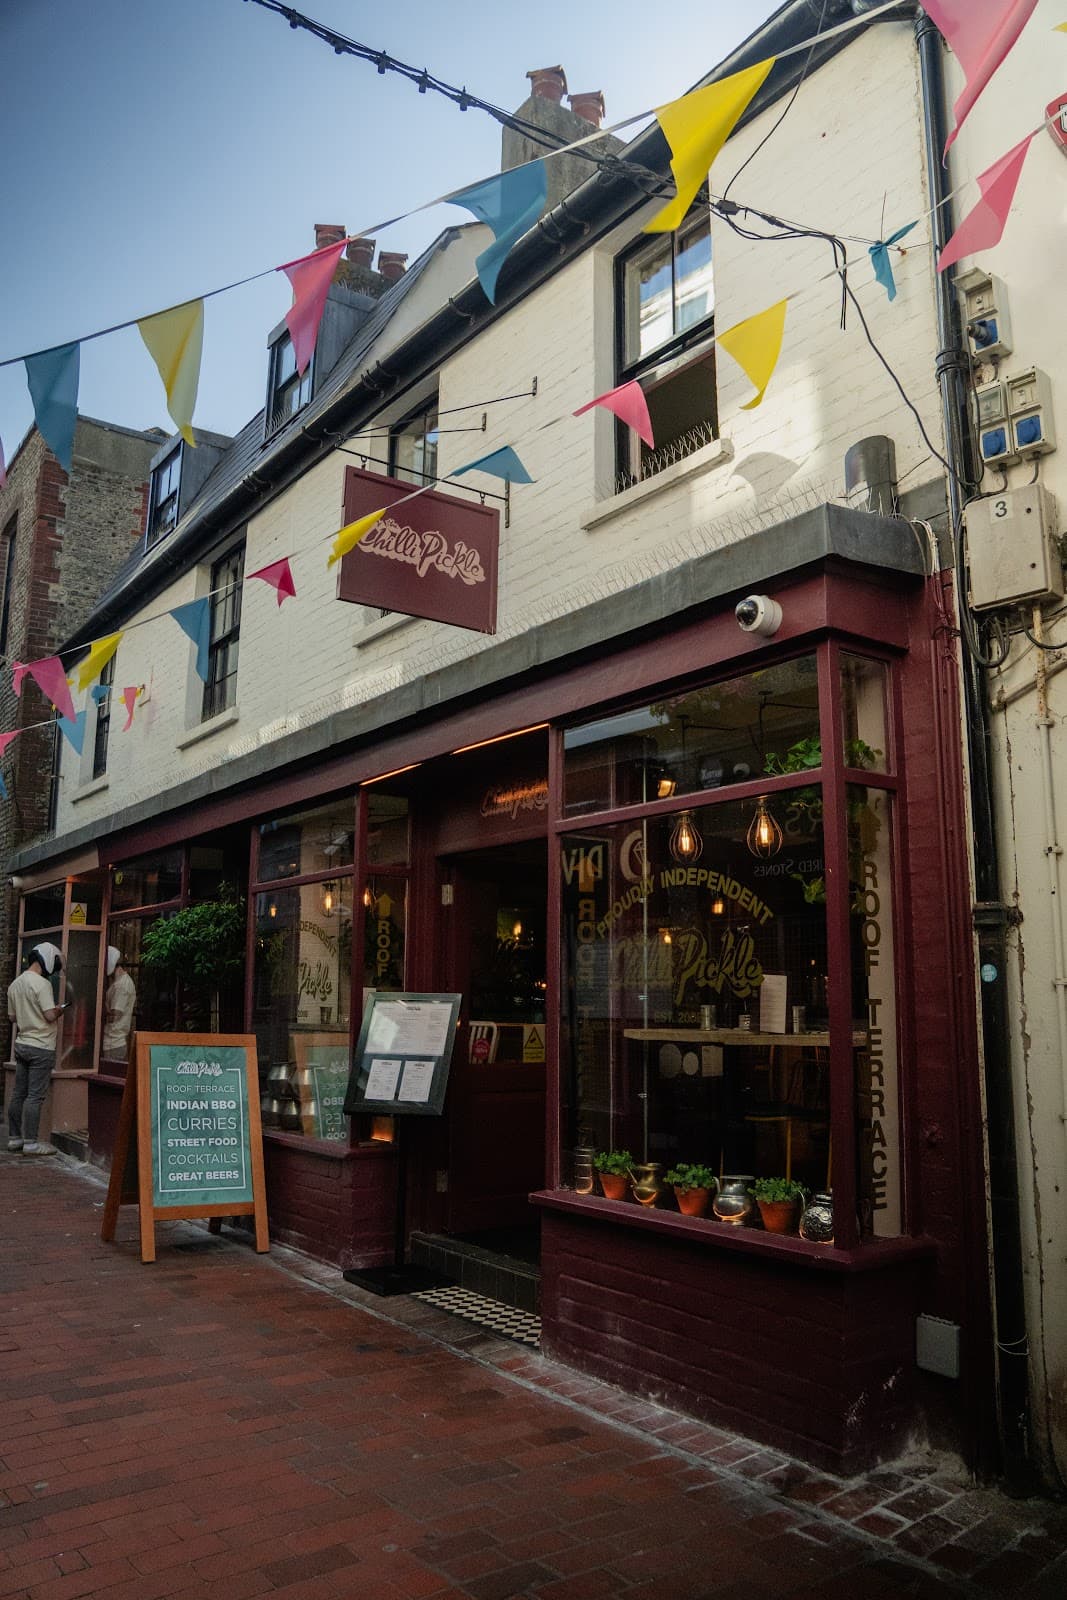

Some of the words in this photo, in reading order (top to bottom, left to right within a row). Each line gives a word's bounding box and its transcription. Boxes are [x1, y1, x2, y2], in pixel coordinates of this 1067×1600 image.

[995, 500, 1008, 518] 3
[358, 525, 418, 563] Chilli
[416, 530, 485, 583] Pickle
[596, 876, 655, 940] PROUDLY
[660, 867, 775, 926] INDEPENDENT
[861, 861, 882, 977] ROOF
[299, 920, 338, 958] DEPENDENT
[376, 919, 391, 978] ROOF
[672, 927, 765, 1006] Pickle
[166, 1085, 192, 1093] ROOF
[195, 1085, 236, 1093] TERRACE
[166, 1100, 209, 1110] INDIAN
[211, 1100, 237, 1110] BBQ
[866, 998, 888, 1212] TERRACE
[167, 1117, 237, 1132] CURRIES
[167, 1138, 206, 1148] STREET
[208, 1137, 238, 1146] FOOD
[168, 1153, 239, 1166] COCKTAILS
[168, 1172, 204, 1182] GREAT
[205, 1170, 239, 1180] BEERS
